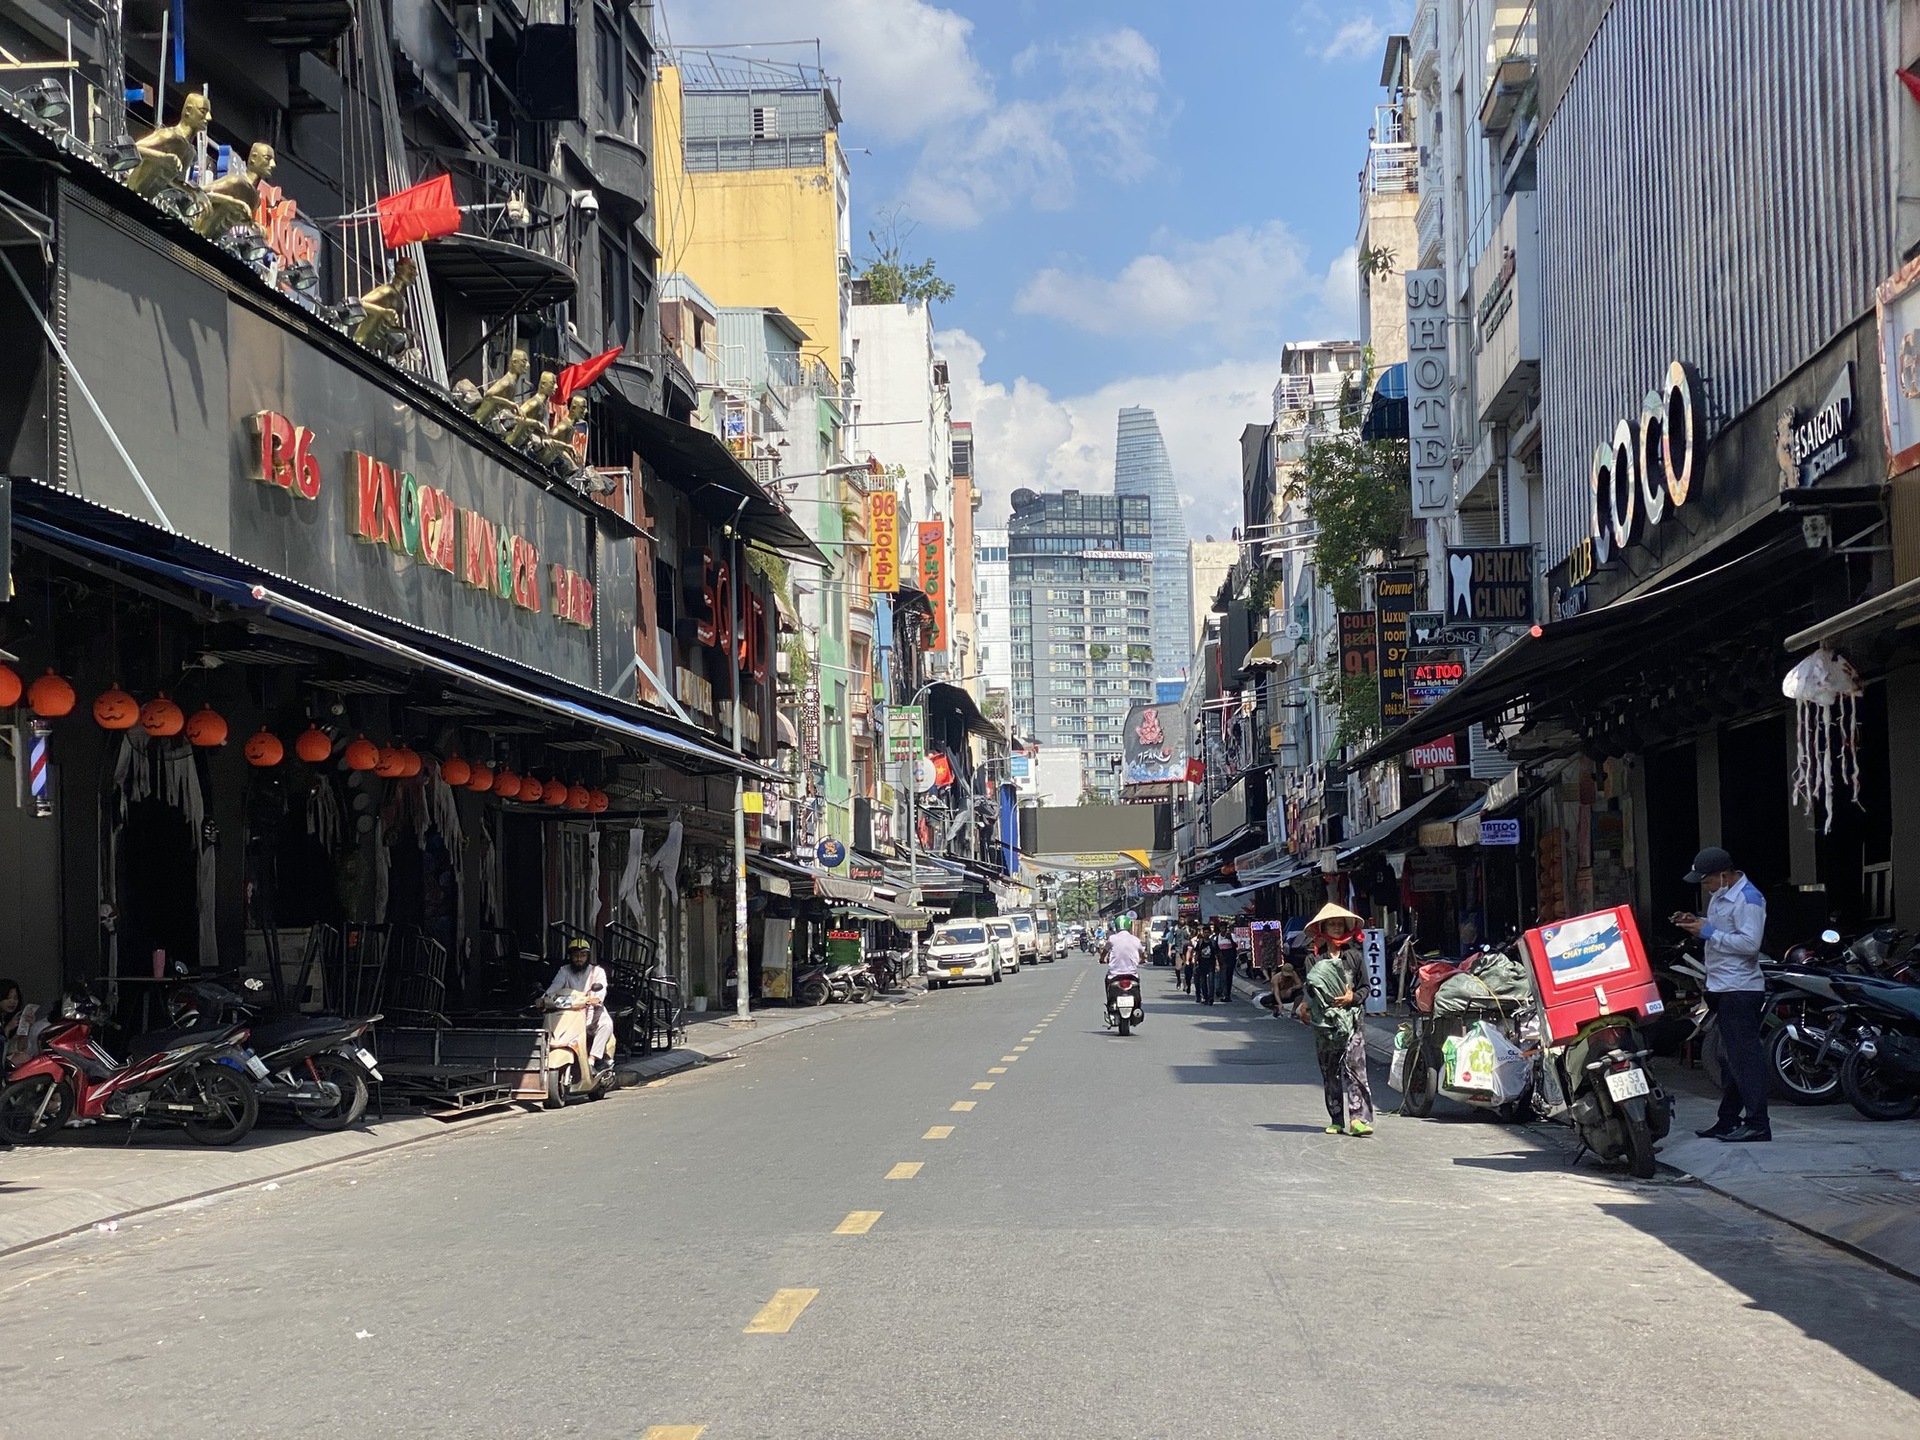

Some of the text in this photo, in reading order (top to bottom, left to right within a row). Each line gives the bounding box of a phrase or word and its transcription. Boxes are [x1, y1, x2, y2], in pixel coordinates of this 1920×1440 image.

[1407, 279, 1445, 308] 99
[1411, 316, 1448, 509] HOTEL
[1800, 398, 1843, 459] SAIGON
[1591, 361, 1693, 565] COCO
[872, 494, 896, 517] 96
[350, 451, 594, 629] KNOCK KNOCK BAR
[874, 518, 893, 591] HOTEL
[1474, 551, 1528, 582] DENTAL
[1569, 537, 1592, 588] CLUB
[1379, 580, 1413, 596] Crowne
[1474, 587, 1526, 617] CLINIC
[1343, 615, 1375, 629] COLD
[1343, 632, 1376, 647] BEER
[1345, 650, 1376, 680] 91
[1388, 648, 1408, 661] 97
[1415, 744, 1454, 764] PHÒNG
[1482, 823, 1517, 831] TATTOO
[1368, 931, 1381, 998] TATTOO
[1562, 942, 1606, 960] CHẤT RIÊNG
[1650, 1003, 1662, 1011] 003
